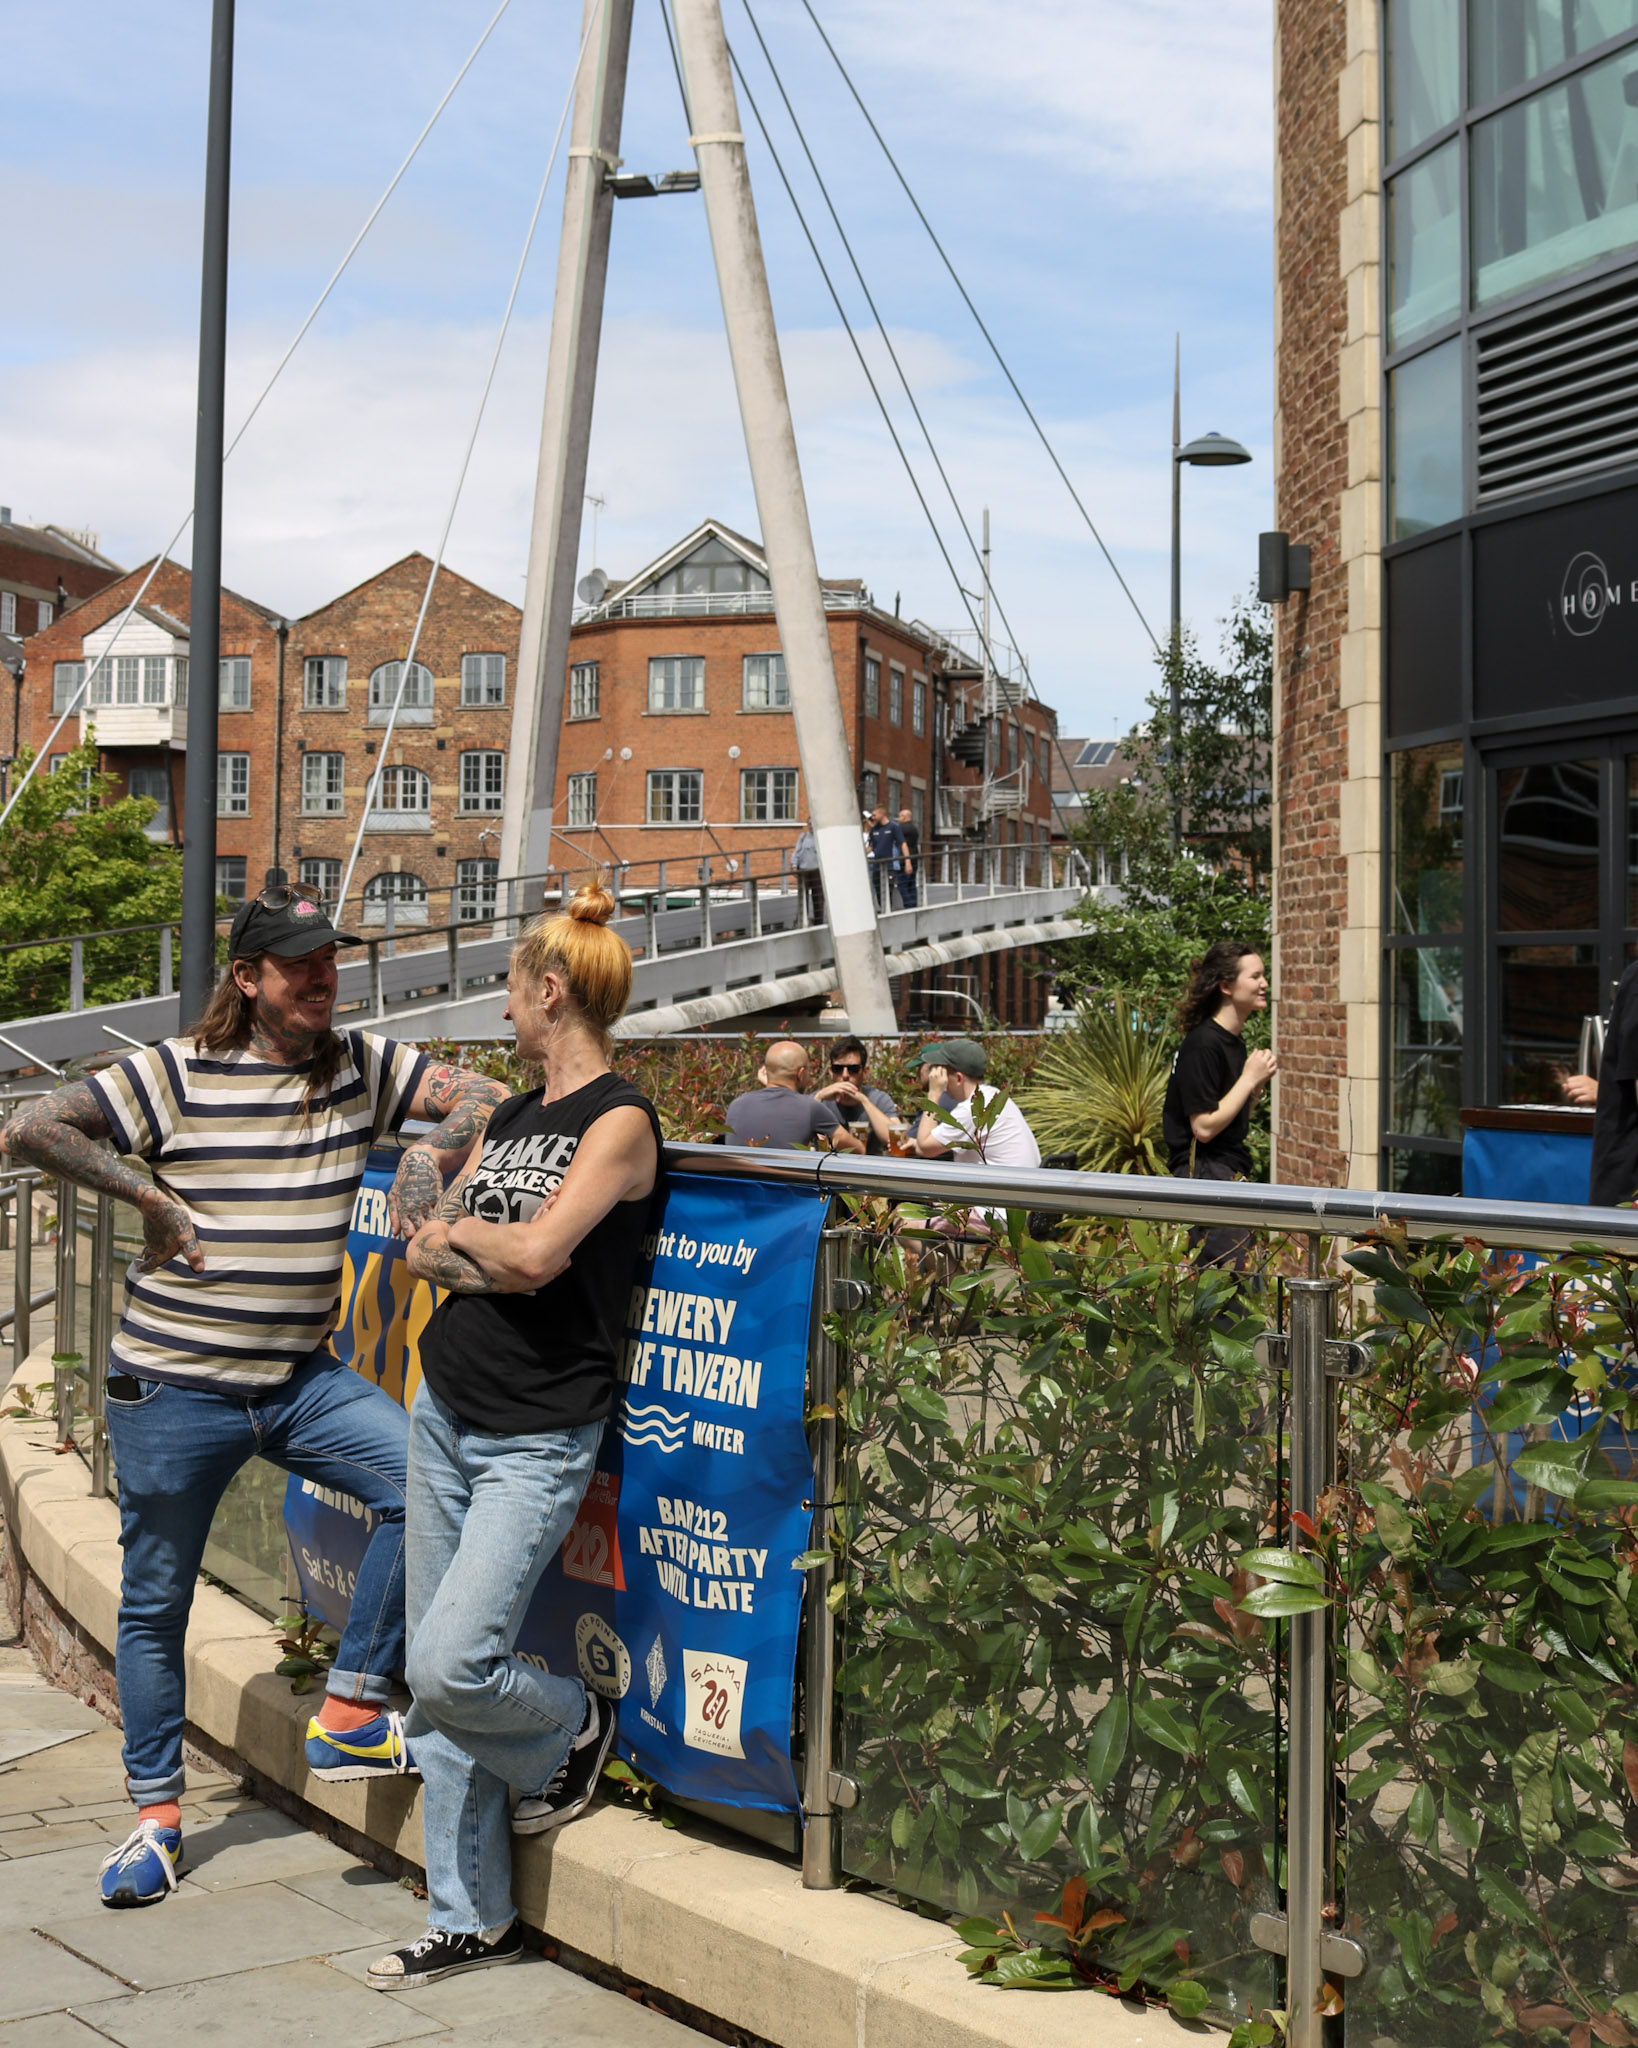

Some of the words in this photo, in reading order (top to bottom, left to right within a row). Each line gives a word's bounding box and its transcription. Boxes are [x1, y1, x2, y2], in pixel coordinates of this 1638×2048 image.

[1564, 580, 1638, 616] HOME
[481, 1134, 578, 1176] MAKE
[467, 1169, 564, 1196] PCAKES
[639, 1228, 676, 1262] ught
[677, 1233, 697, 1261] to
[696, 1241, 730, 1269] you
[732, 1238, 758, 1275] by
[626, 1284, 738, 1346] REWERY
[615, 1336, 657, 1388] ARF
[660, 1344, 763, 1410] TAVERN
[692, 1420, 746, 1455] WATER
[301, 1547, 325, 1585] Sat
[322, 1558, 336, 1590] 5
[335, 1564, 348, 1598] &
[655, 1559, 690, 1605] UNTIL
[693, 1576, 755, 1615] LATE
[577, 1618, 589, 1642] FIVE
[590, 1616, 625, 1652] POINTS
[592, 1643, 610, 1671] 5
[580, 1661, 622, 1696] BREWING
[690, 1661, 741, 1695] SALMA
[640, 1706, 668, 1736] KIRKSTALL
[693, 1735, 733, 1751] CEVICHERIA
